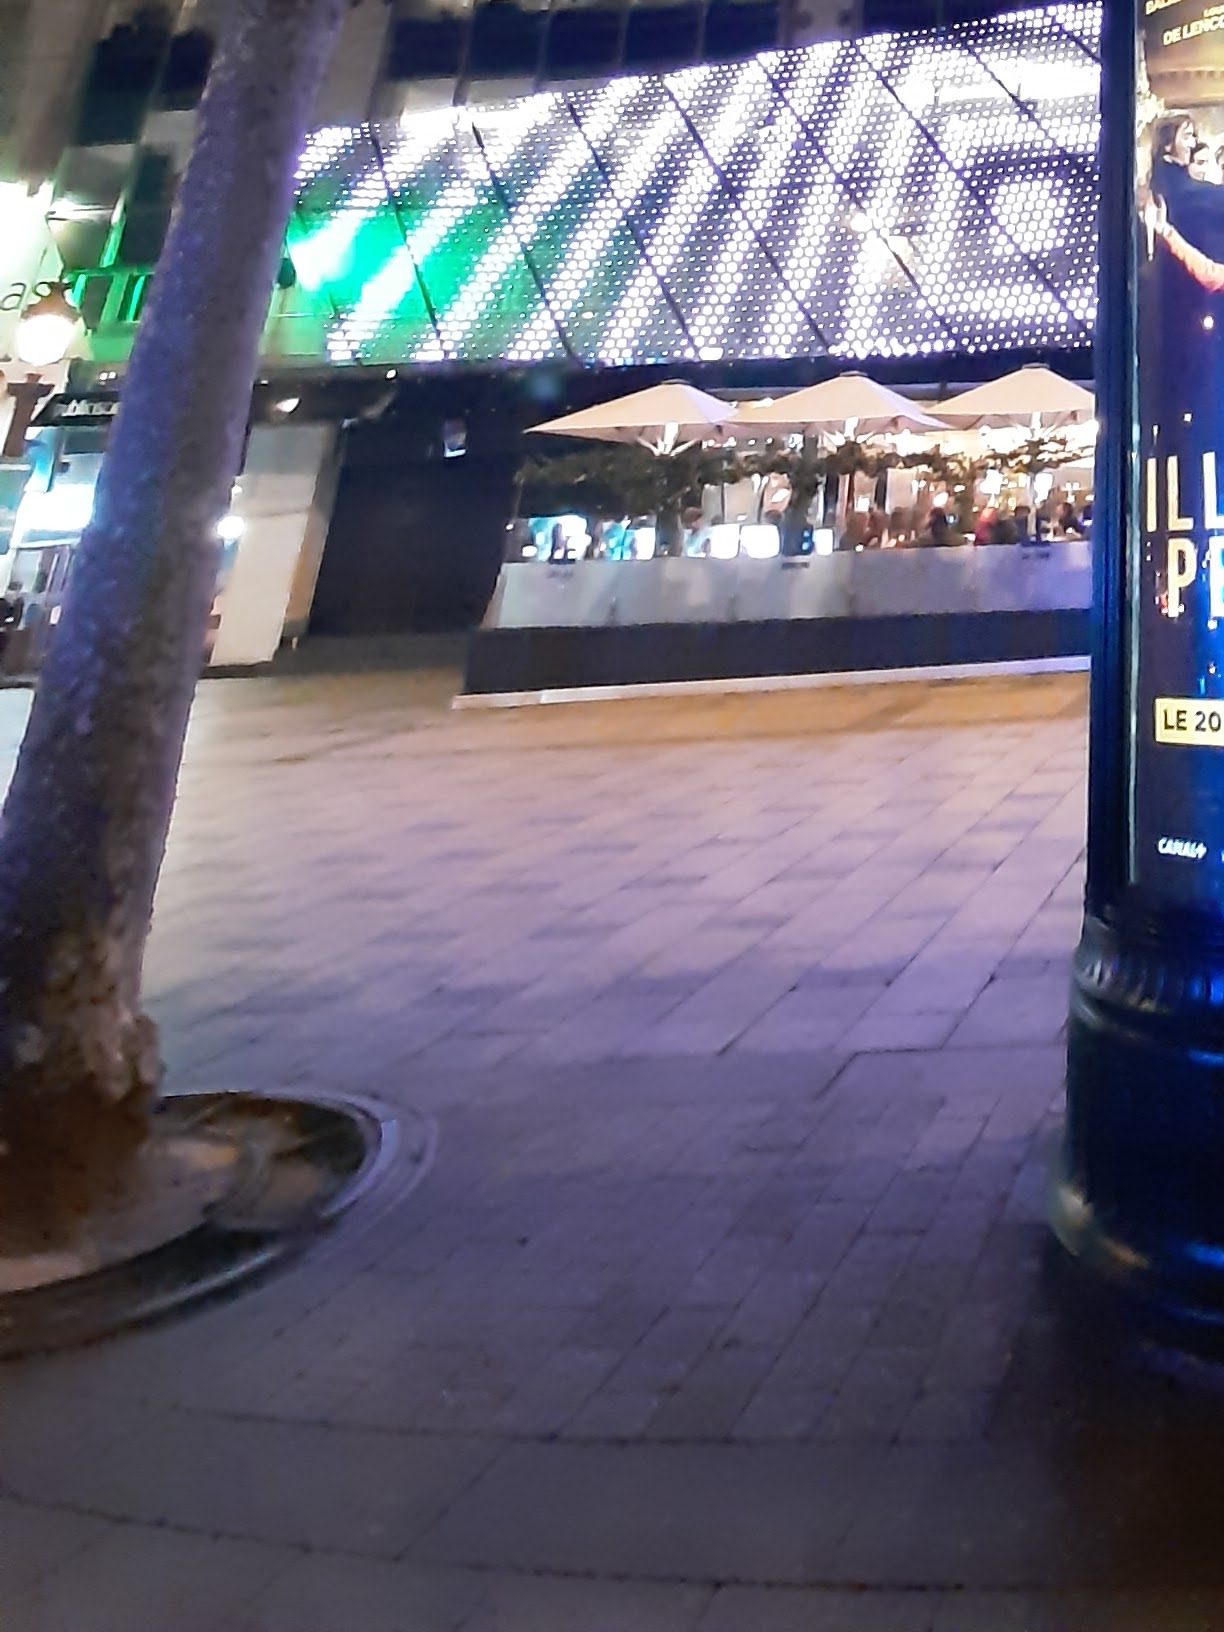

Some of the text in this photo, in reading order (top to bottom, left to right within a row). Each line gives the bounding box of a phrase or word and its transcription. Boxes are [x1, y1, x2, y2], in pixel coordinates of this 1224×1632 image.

[1163, 26, 1182, 46] DE
[1163, 708, 1188, 731] LE
[1195, 710, 1222, 733] 20
